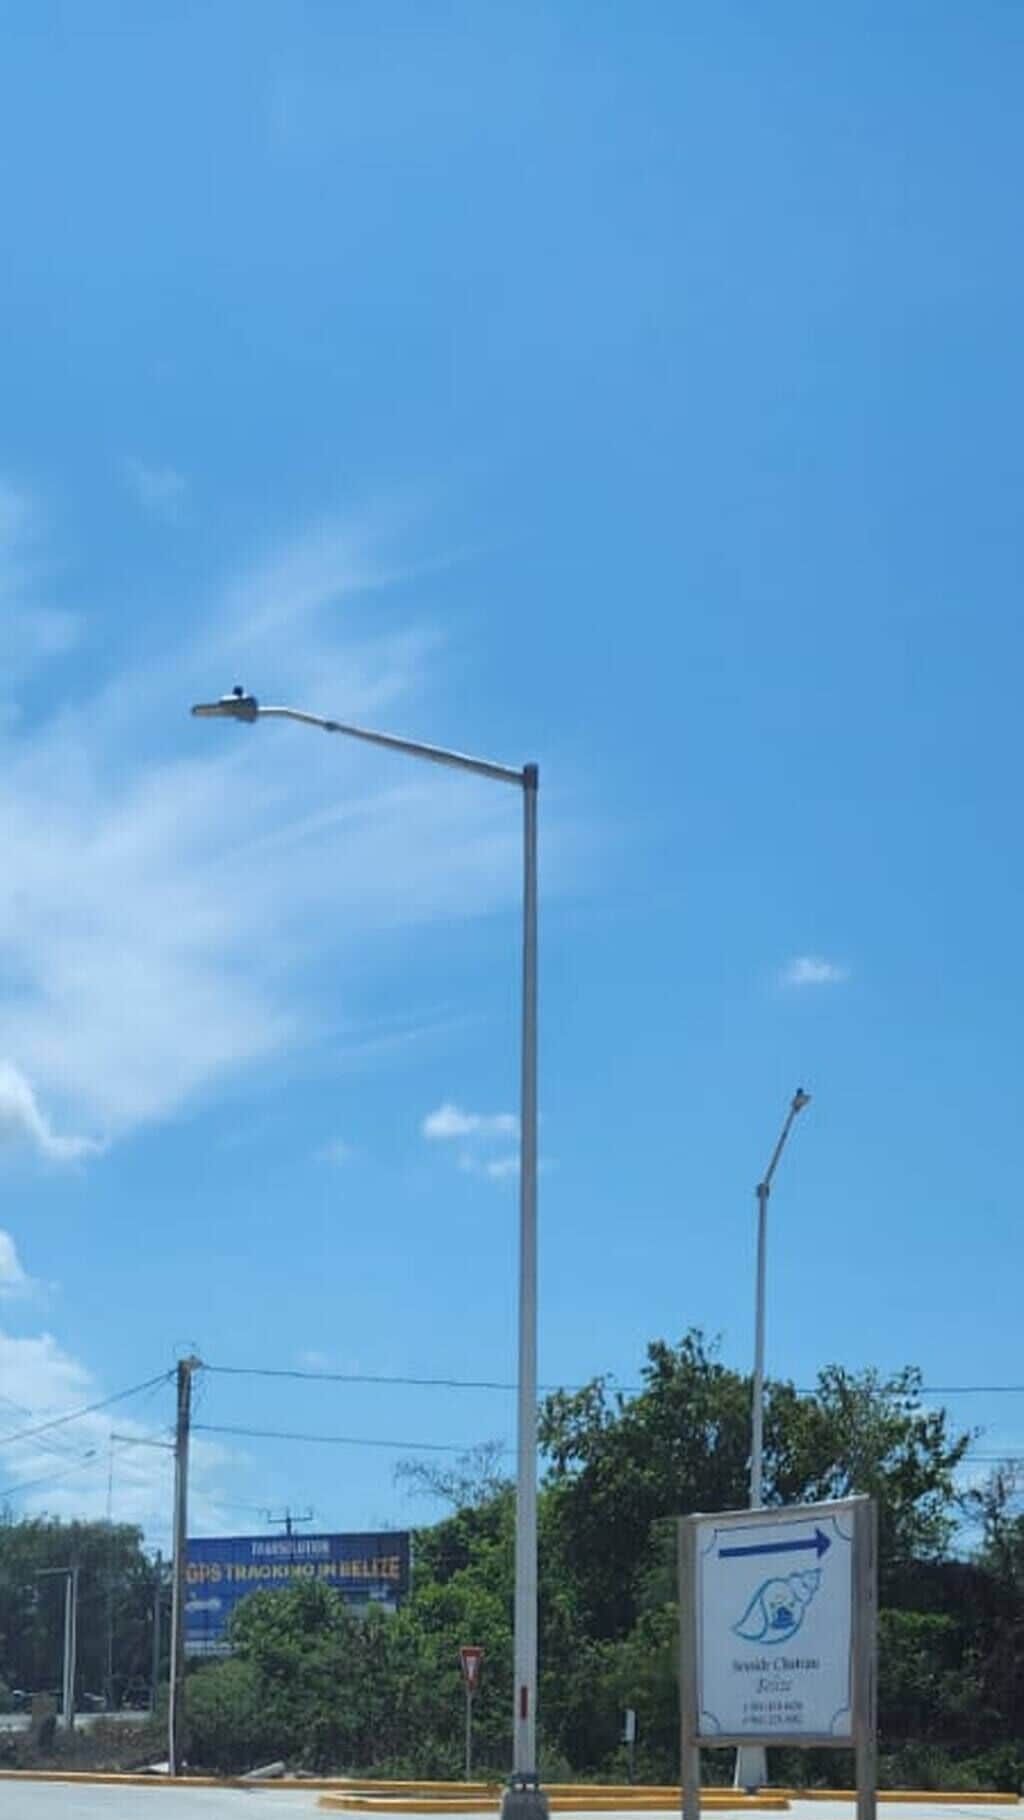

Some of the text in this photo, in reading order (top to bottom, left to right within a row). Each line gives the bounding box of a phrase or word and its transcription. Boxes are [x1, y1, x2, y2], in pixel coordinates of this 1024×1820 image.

[186, 1555, 400, 1584] GPS TRACKING IN BELIZE
